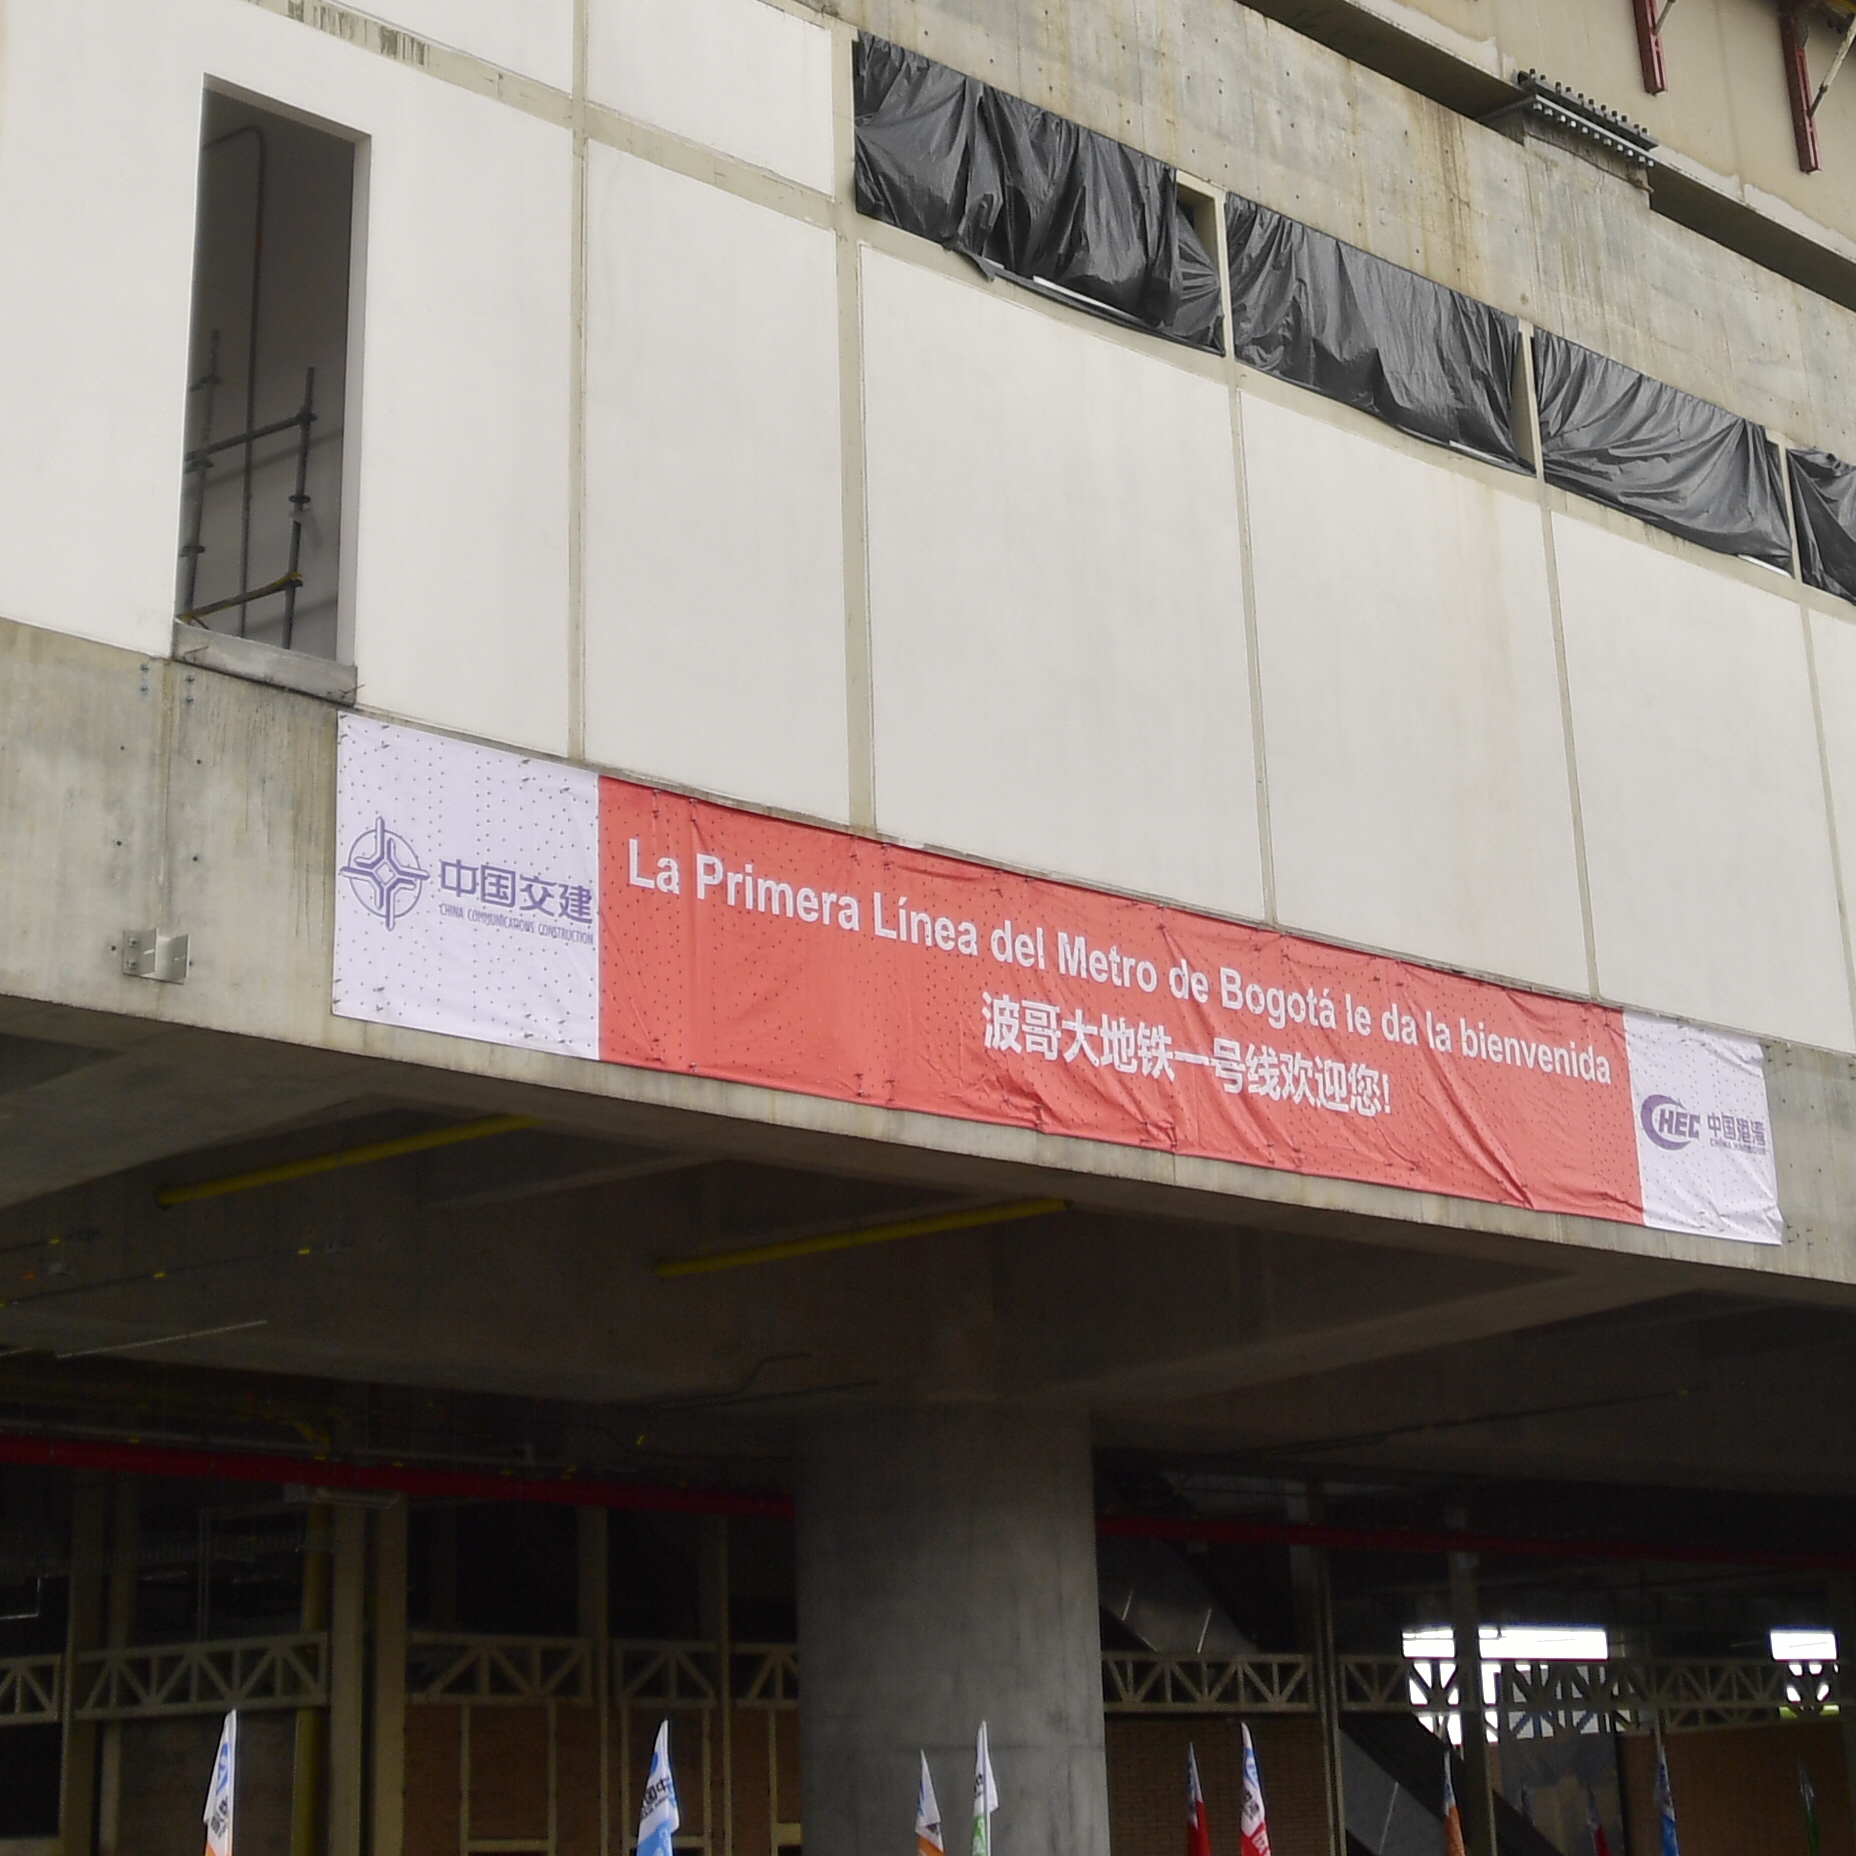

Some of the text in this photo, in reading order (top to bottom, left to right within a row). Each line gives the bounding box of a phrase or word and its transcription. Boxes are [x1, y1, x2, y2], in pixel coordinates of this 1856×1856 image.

[440, 858, 593, 925] 中国交建
[439, 902, 594, 945] CHINA COMMUNICATIONS CONSTRUCTION
[628, 837, 1612, 1085] La Primera Línea del Metro de Bogotá le da la bienvenida
[1707, 1111, 1766, 1147] 中国港湾
